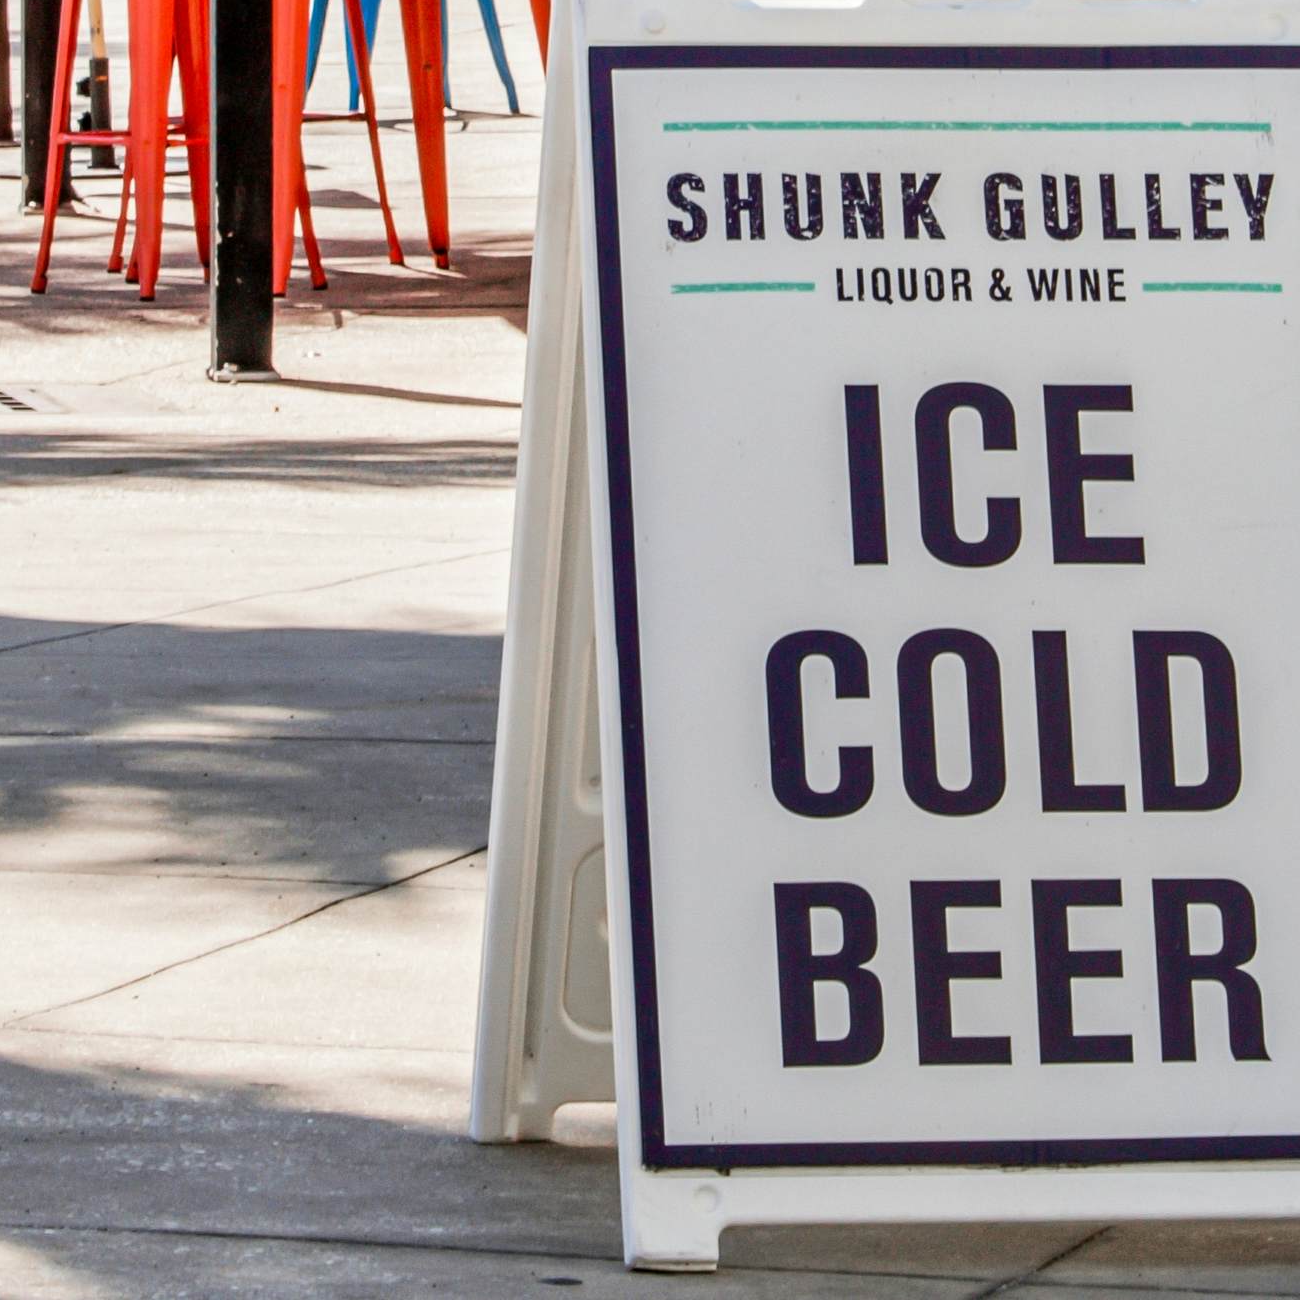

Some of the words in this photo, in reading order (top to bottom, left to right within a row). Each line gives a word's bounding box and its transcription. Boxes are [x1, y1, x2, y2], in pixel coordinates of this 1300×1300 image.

[666, 172, 946, 242] SHUNK
[984, 172, 1275, 242] GULLEY
[836, 268, 973, 304] LIQUOR
[989, 269, 1012, 302] &
[1027, 269, 1127, 302] WINE
[844, 382, 1146, 568] ICE
[765, 628, 1242, 819] COLD
[773, 878, 1272, 1067] BEER
